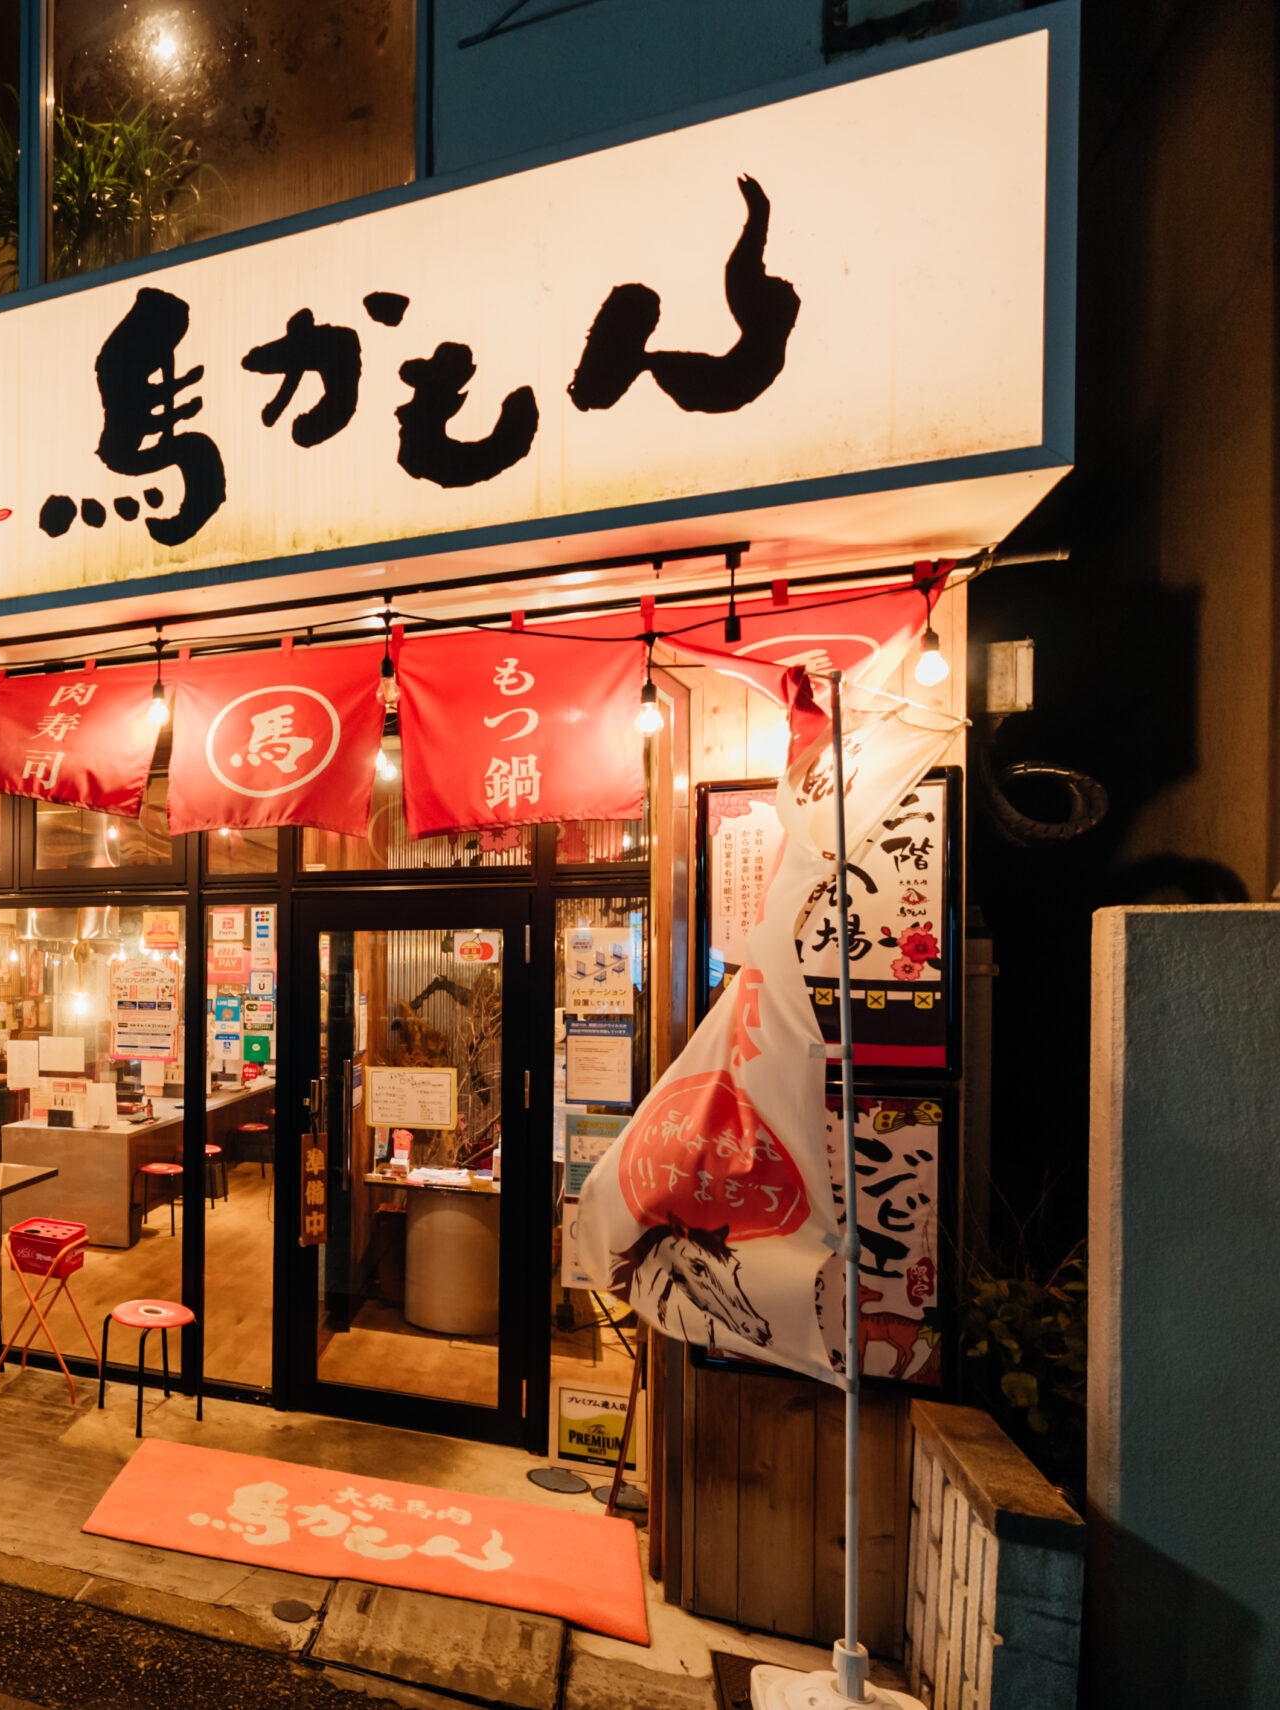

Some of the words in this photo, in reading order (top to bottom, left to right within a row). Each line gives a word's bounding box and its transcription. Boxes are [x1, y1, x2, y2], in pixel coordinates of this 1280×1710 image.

[21, 682, 99, 791] 肉寿司
[229, 704, 313, 774] 馬
[482, 657, 542, 810] もつ鍋
[879, 793, 936, 873] 二階
[218, 958, 238, 968] PAY
[571, 988, 628, 996] パーテーション
[304, 1147, 327, 1237] 準備中
[853, 1136, 934, 1279] ジビエ
[567, 1396, 628, 1412] プレミアム達人店
[333, 1485, 472, 1526] 大衆馬肉
